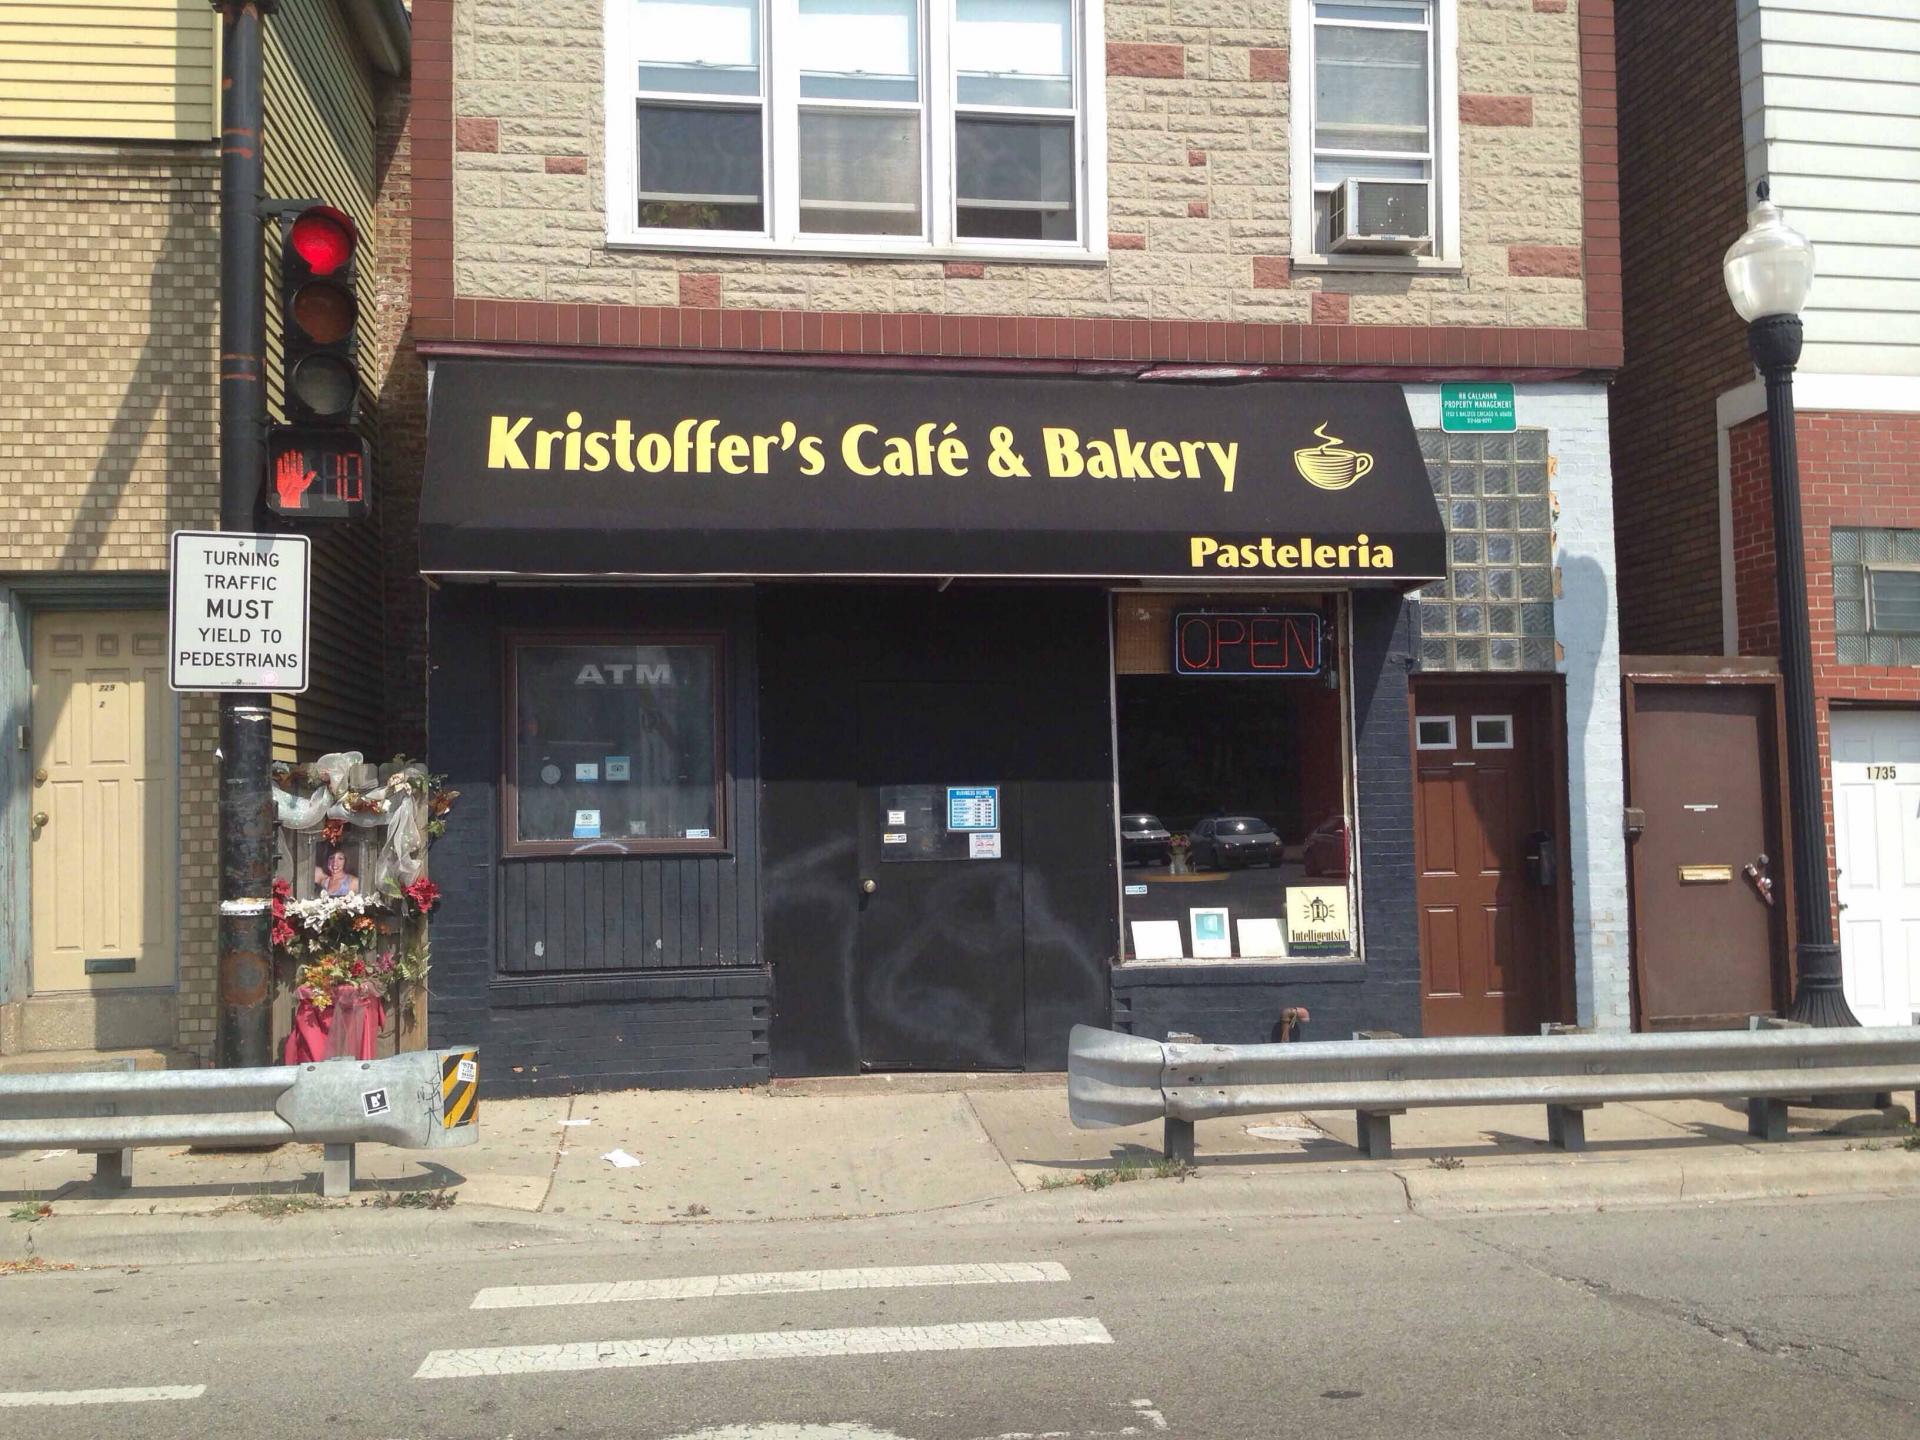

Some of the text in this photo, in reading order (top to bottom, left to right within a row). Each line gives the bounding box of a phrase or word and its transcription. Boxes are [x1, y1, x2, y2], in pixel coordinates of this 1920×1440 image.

[1444, 400, 1512, 409] PROPERTY MANAGEMENT
[1468, 392, 1497, 400] CALLAHAN
[841, 422, 969, 477] Café
[987, 425, 1032, 478] &
[1042, 427, 1239, 493] Bakery
[203, 550, 280, 567] TURNING
[1190, 534, 1394, 568] Pasteleria
[204, 574, 277, 591] TRAFFIC
[206, 598, 274, 619] MUST
[198, 627, 282, 644] YIELD TO
[1181, 618, 1315, 670] OPEN
[180, 651, 298, 668] PEDESTRIANS
[574, 664, 674, 685] ATM
[1867, 765, 1897, 780] 1735
